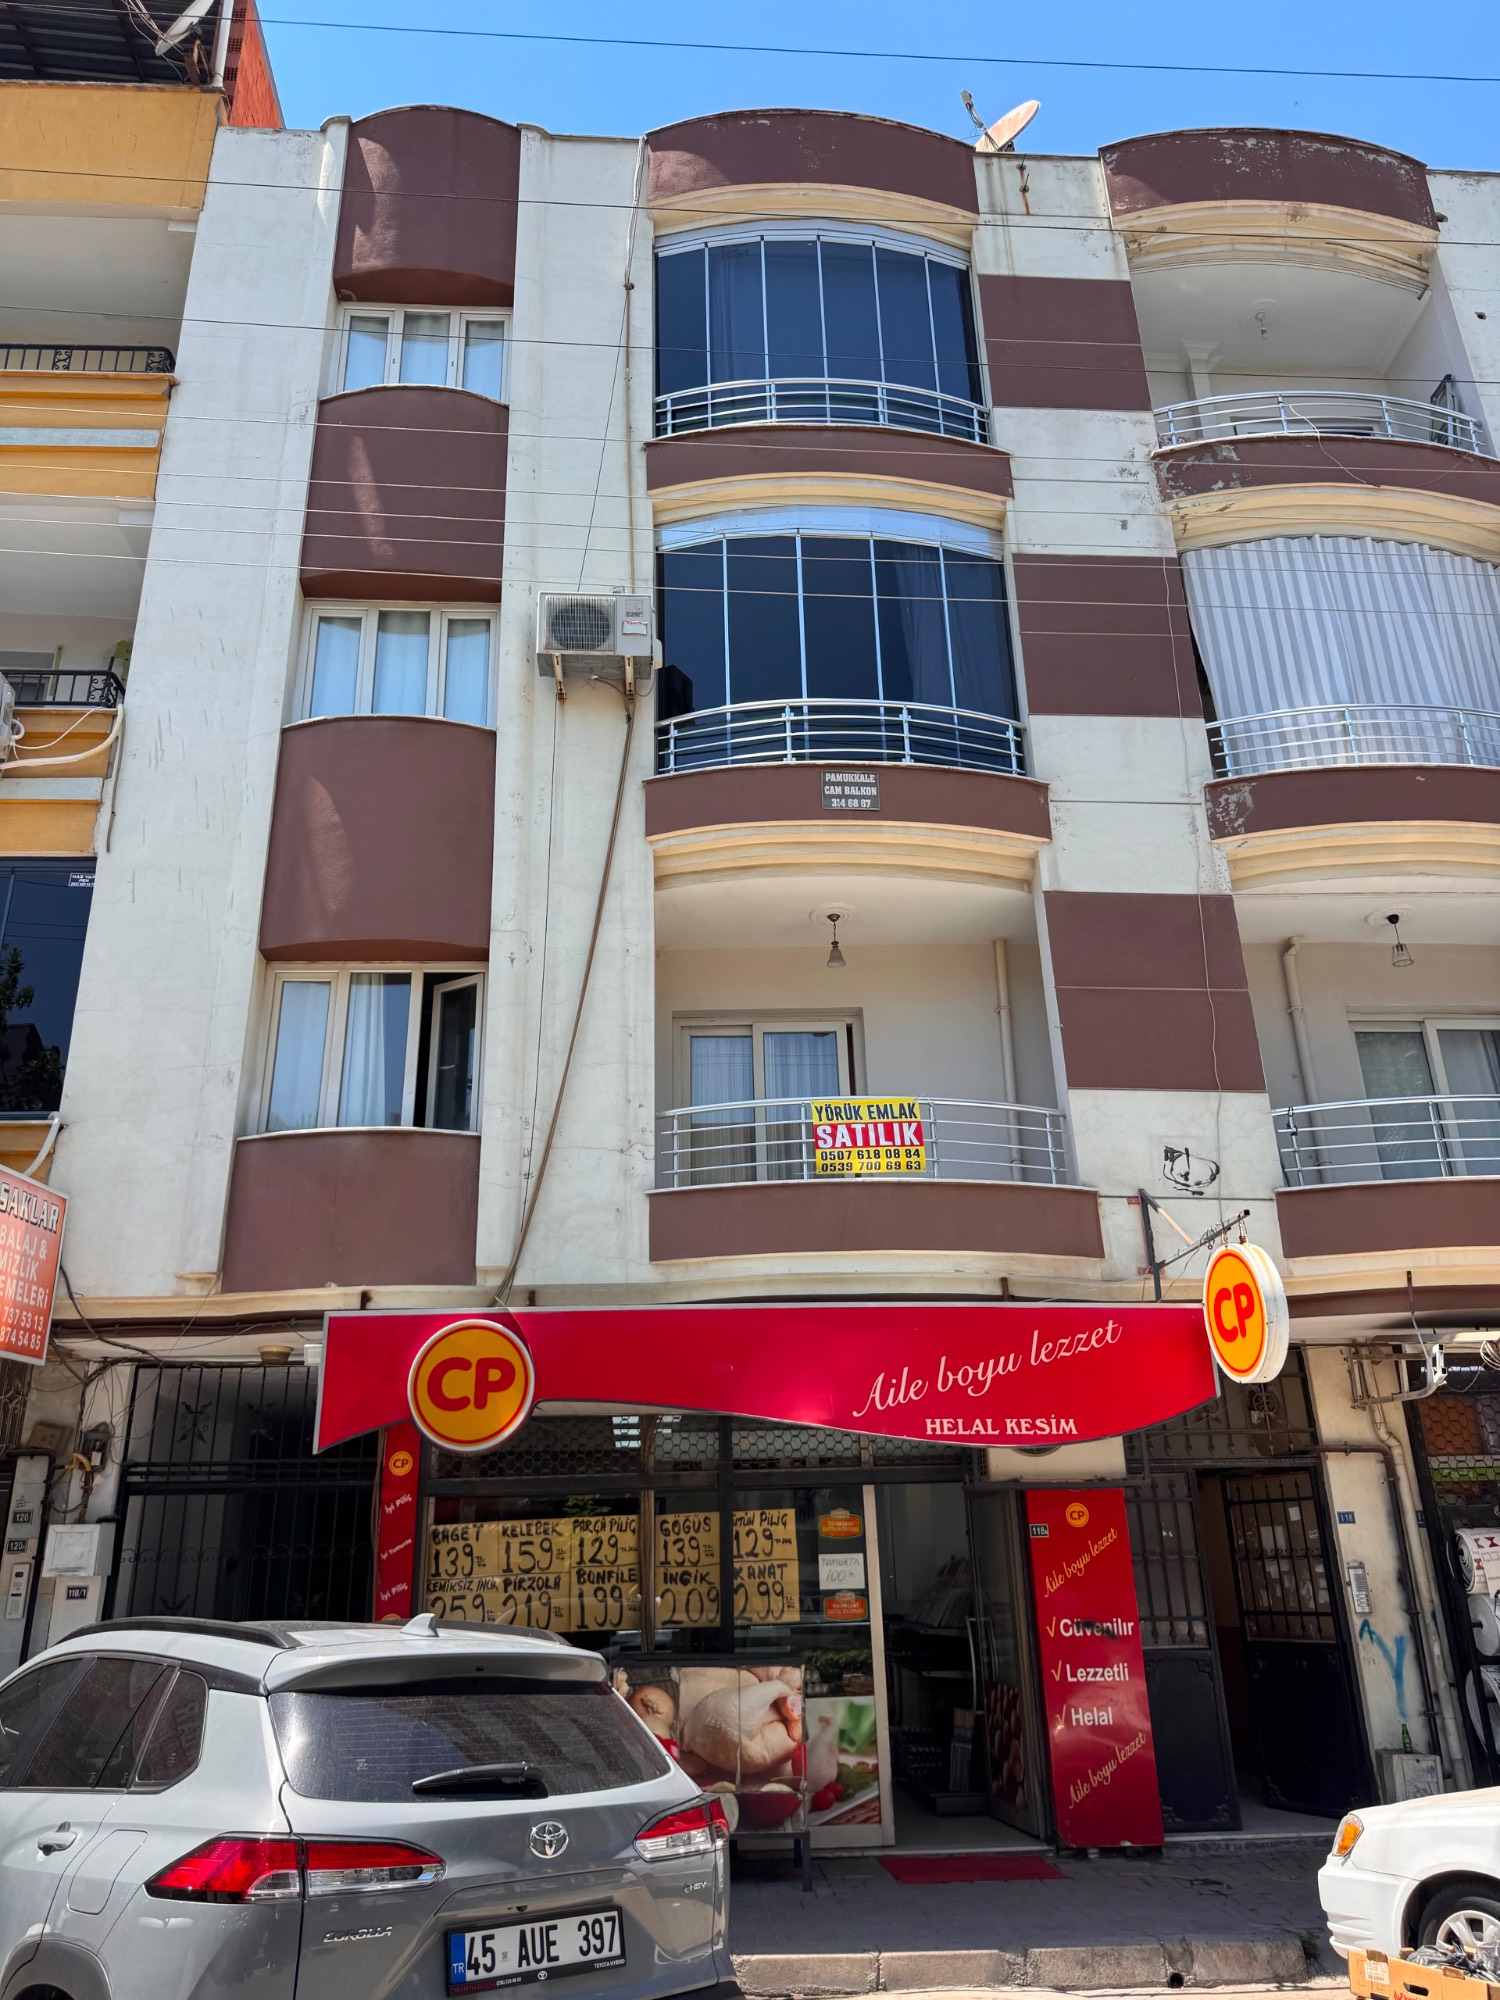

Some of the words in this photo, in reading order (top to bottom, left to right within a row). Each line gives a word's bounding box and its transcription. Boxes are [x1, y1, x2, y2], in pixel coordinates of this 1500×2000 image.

[825, 773, 876, 783] PAMUKKALE
[824, 785, 842, 795] CAM
[844, 786, 877, 796] BALKON
[814, 1102, 863, 1121] YÖRÜK
[866, 1102, 918, 1120] EMLAK
[816, 1122, 920, 1149] SATILIK
[820, 1150, 852, 1161] 0507
[857, 1149, 880, 1160] 618
[885, 1149, 901, 1159] 08
[905, 1148, 920, 1159] 84
[821, 1162, 853, 1172] 0539
[858, 1161, 881, 1171] 700
[886, 1161, 901, 1171] 69
[906, 1160, 921, 1171] 63
[39, 1239, 48, 1260] &
[21, 1310, 32, 1328] 53
[34, 1314, 44, 1332] 13
[1213, 1282, 1255, 1343] CP
[18, 1329, 29, 1347] 54
[30, 1333, 41, 1351] 85
[852, 1366, 929, 1418] Aile
[936, 1355, 1023, 1397] boyu
[1030, 1319, 1123, 1366] lezzet
[427, 1357, 516, 1412] CP
[925, 1418, 1000, 1436] HELAL
[1005, 1414, 1078, 1436] KESİM
[393, 1458, 409, 1469] CP
[16, 1513, 29, 1522] 120
[660, 1514, 712, 1537] GÖĞÜS
[1069, 1510, 1085, 1521] CP
[1340, 1514, 1354, 1522] 118
[431, 1524, 484, 1545] BAGET
[501, 1521, 564, 1538] KELEBEK
[576, 1533, 618, 1566] 129
[660, 1535, 701, 1567] 139
[733, 1528, 773, 1559] 129
[430, 1543, 474, 1578] 139
[502, 1537, 553, 1574] 159
[821, 1556, 861, 1568] YUMURTA
[1043, 1570, 1065, 1598] Aile
[1062, 1551, 1091, 1577] boyu
[1088, 1527, 1118, 1557] lezzet
[734, 1562, 788, 1581] KANAT
[826, 1568, 846, 1582] 100
[503, 1574, 561, 1593] PİRZOLA
[502, 1591, 551, 1630] 219
[576, 1584, 624, 1629] 199
[660, 1586, 719, 1626] 209
[733, 1580, 785, 1622] 299
[1066, 1662, 1129, 1682] Lezzetli
[1071, 1706, 1114, 1727] Helal
[1069, 1779, 1091, 1810] Aile
[1087, 1758, 1117, 1786] boyu
[1115, 1731, 1146, 1764] lezzet
[323, 1926, 393, 1943] COROLLA
[452, 1963, 465, 1975] TR
[466, 1933, 496, 1976] 45
[517, 1924, 560, 1968] AUE
[577, 1915, 617, 1957] 397
